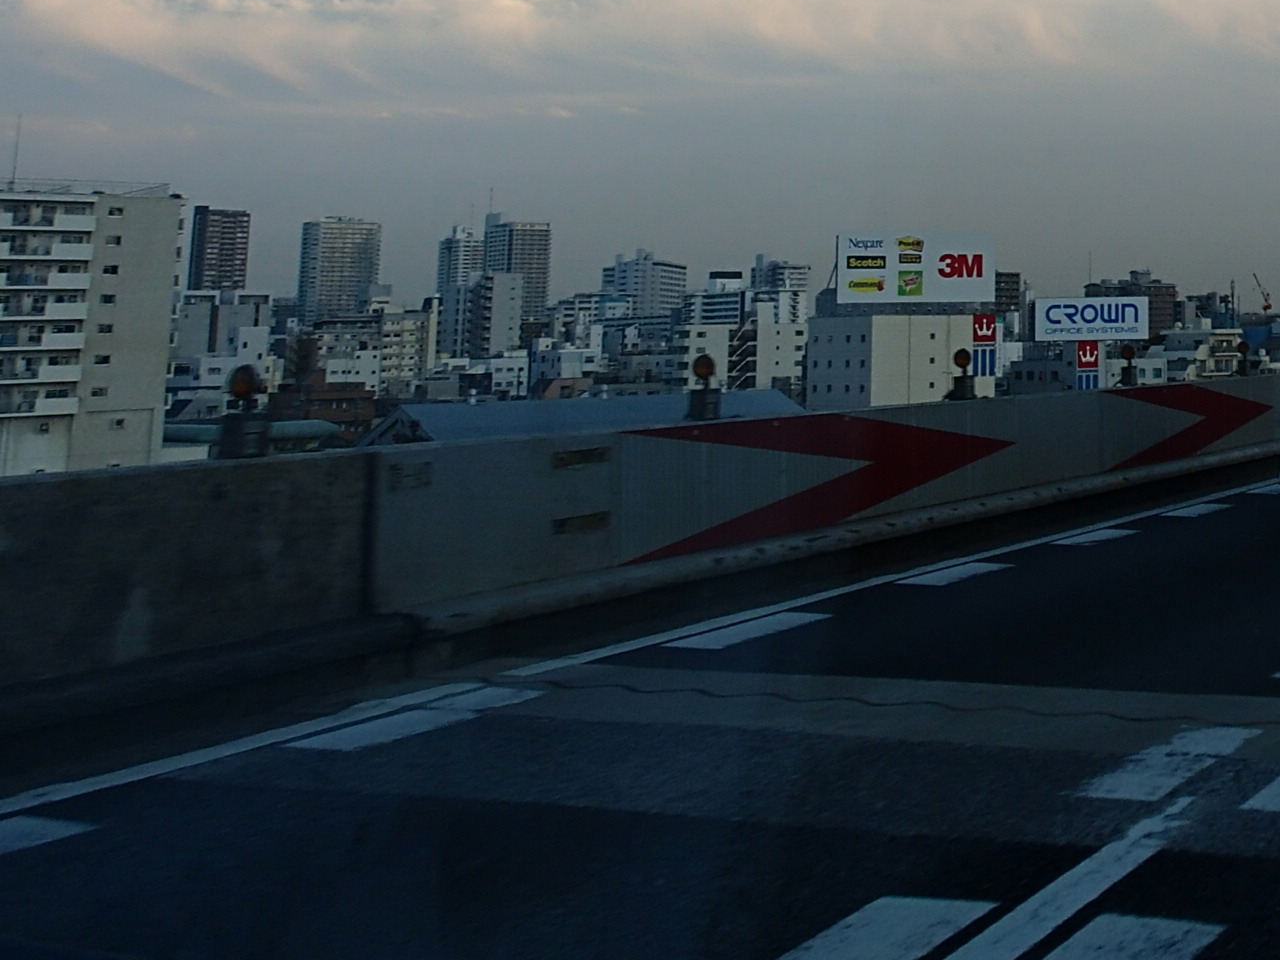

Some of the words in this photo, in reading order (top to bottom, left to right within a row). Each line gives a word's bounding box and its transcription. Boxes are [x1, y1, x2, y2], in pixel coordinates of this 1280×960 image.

[848, 237, 884, 251] Nexcare
[849, 257, 884, 267] Scotch
[938, 253, 983, 279] 3M
[1045, 303, 1139, 325] CROWN
[1045, 327, 1084, 335] OFFICE
[1086, 326, 1139, 335] SYSTEMS
